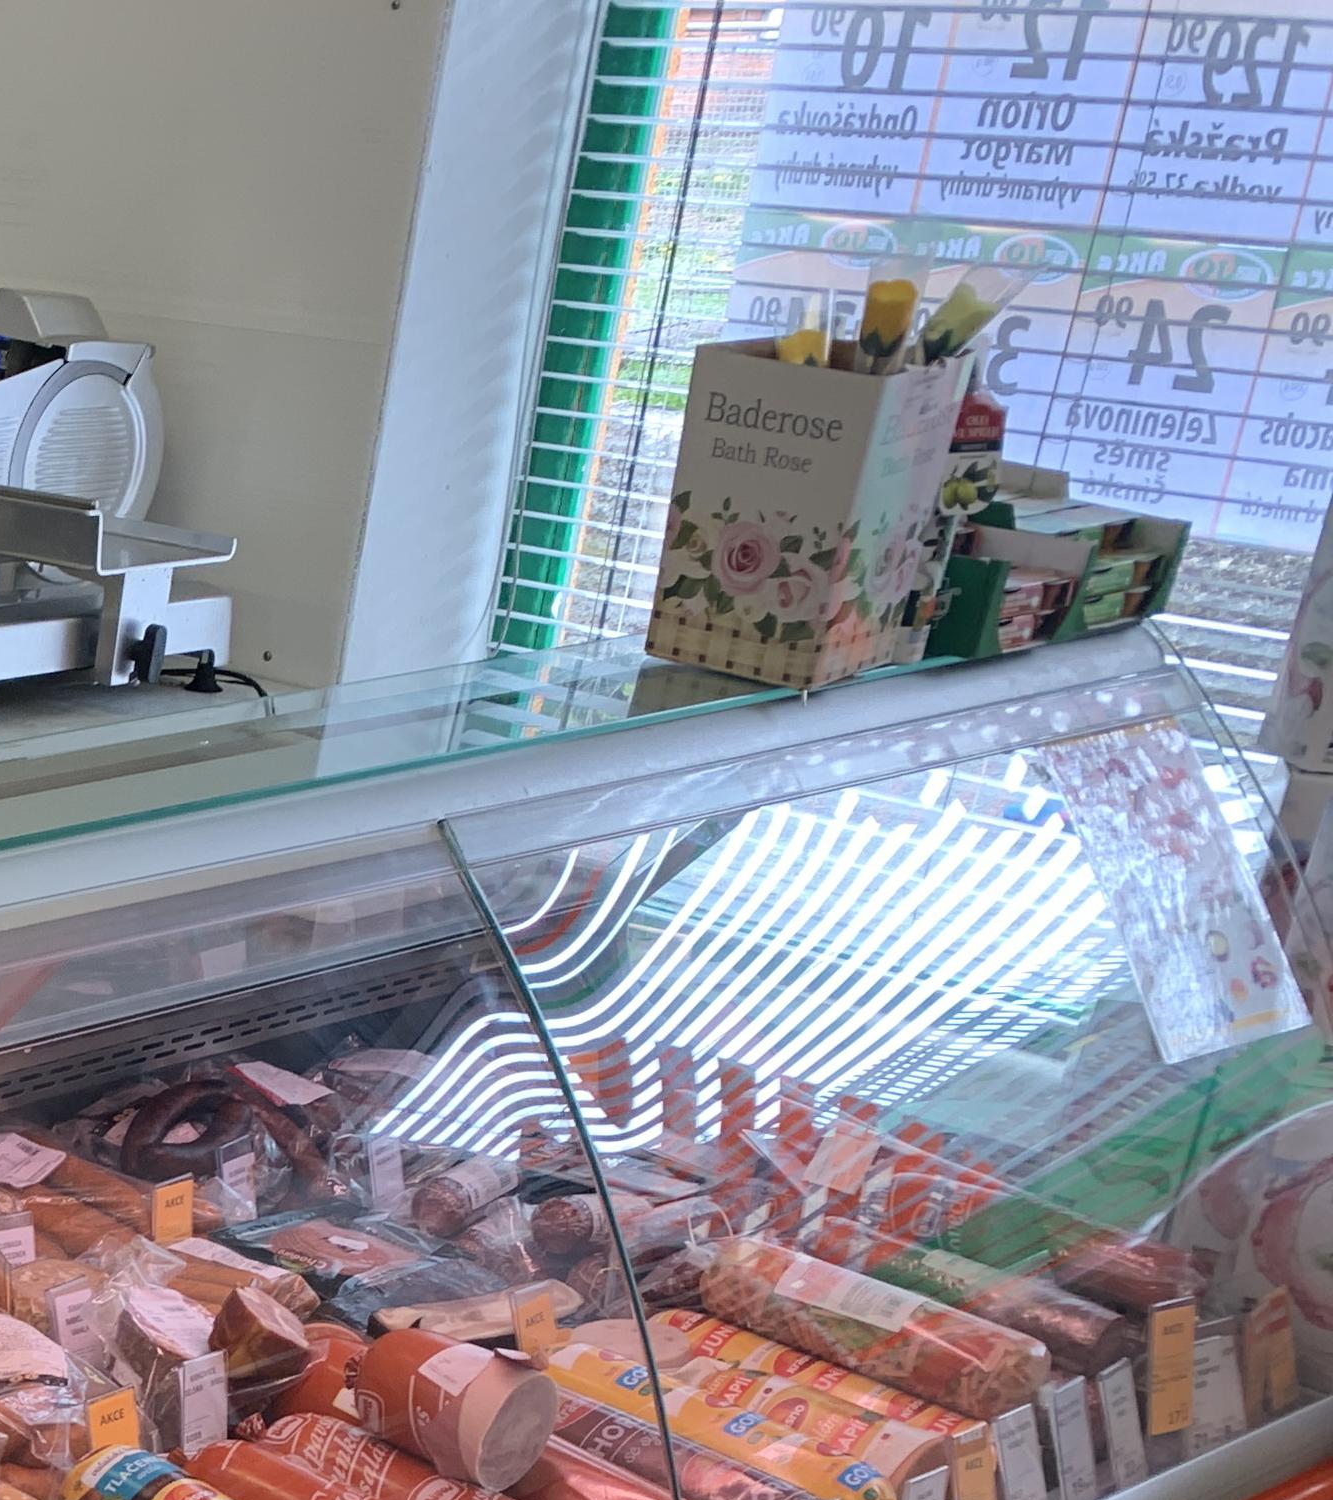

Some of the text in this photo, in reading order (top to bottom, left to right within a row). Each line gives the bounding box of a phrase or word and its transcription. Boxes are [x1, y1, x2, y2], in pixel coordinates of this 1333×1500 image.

[704, 391, 843, 444] Baderose
[711, 438, 814, 475] Bath Rose
